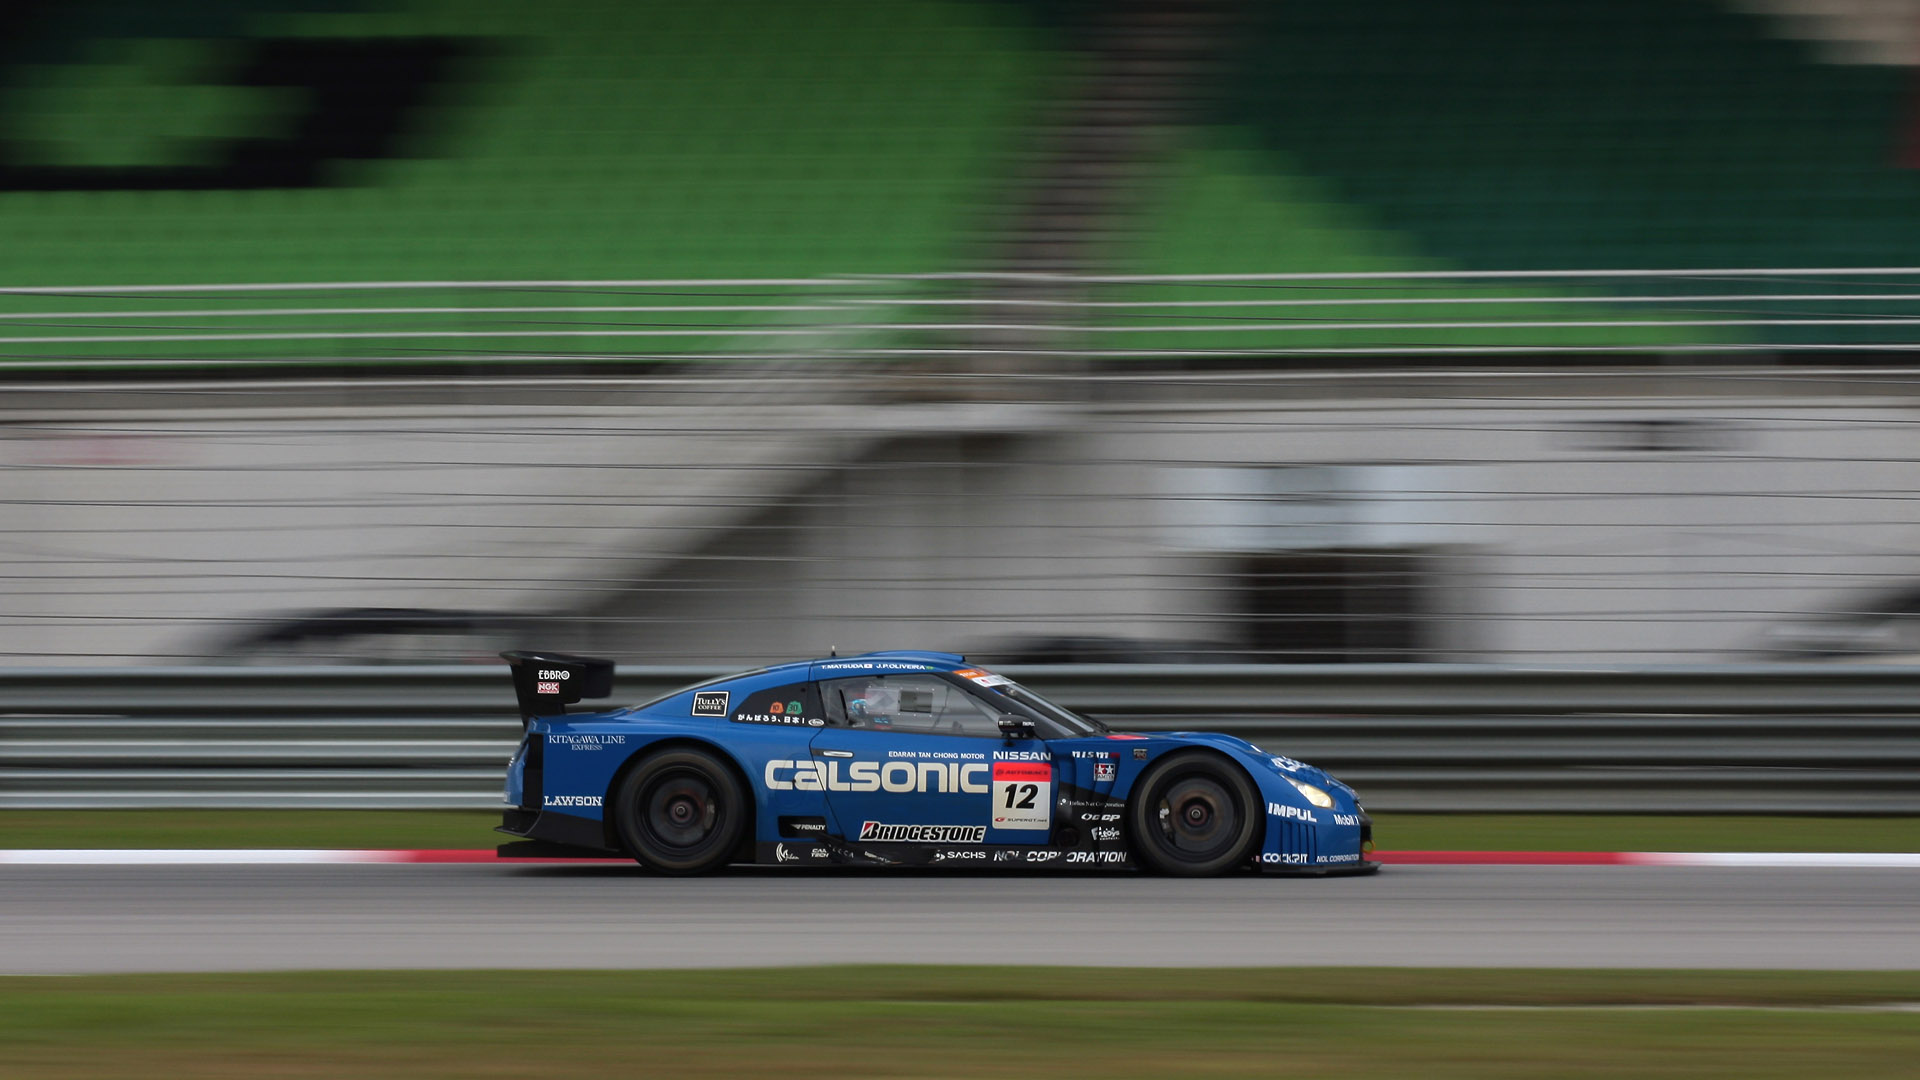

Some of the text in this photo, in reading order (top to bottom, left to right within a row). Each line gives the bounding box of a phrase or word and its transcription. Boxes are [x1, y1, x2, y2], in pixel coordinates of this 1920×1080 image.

[538, 670, 570, 680] EBBRO
[538, 682, 559, 690] NGK
[549, 735, 626, 744] KITAGAWA LINE
[993, 751, 1052, 760] NISSAN
[765, 760, 989, 793] CALSONIC
[544, 796, 602, 806] LAWSON
[1005, 784, 1039, 809] 12
[1268, 802, 1317, 822] IMPUL
[860, 821, 986, 842] BRIDGESTONE
[947, 851, 986, 859] SACHS
[1026, 850, 1127, 863] CORORATION
[1263, 853, 1308, 863] COCKPIT
